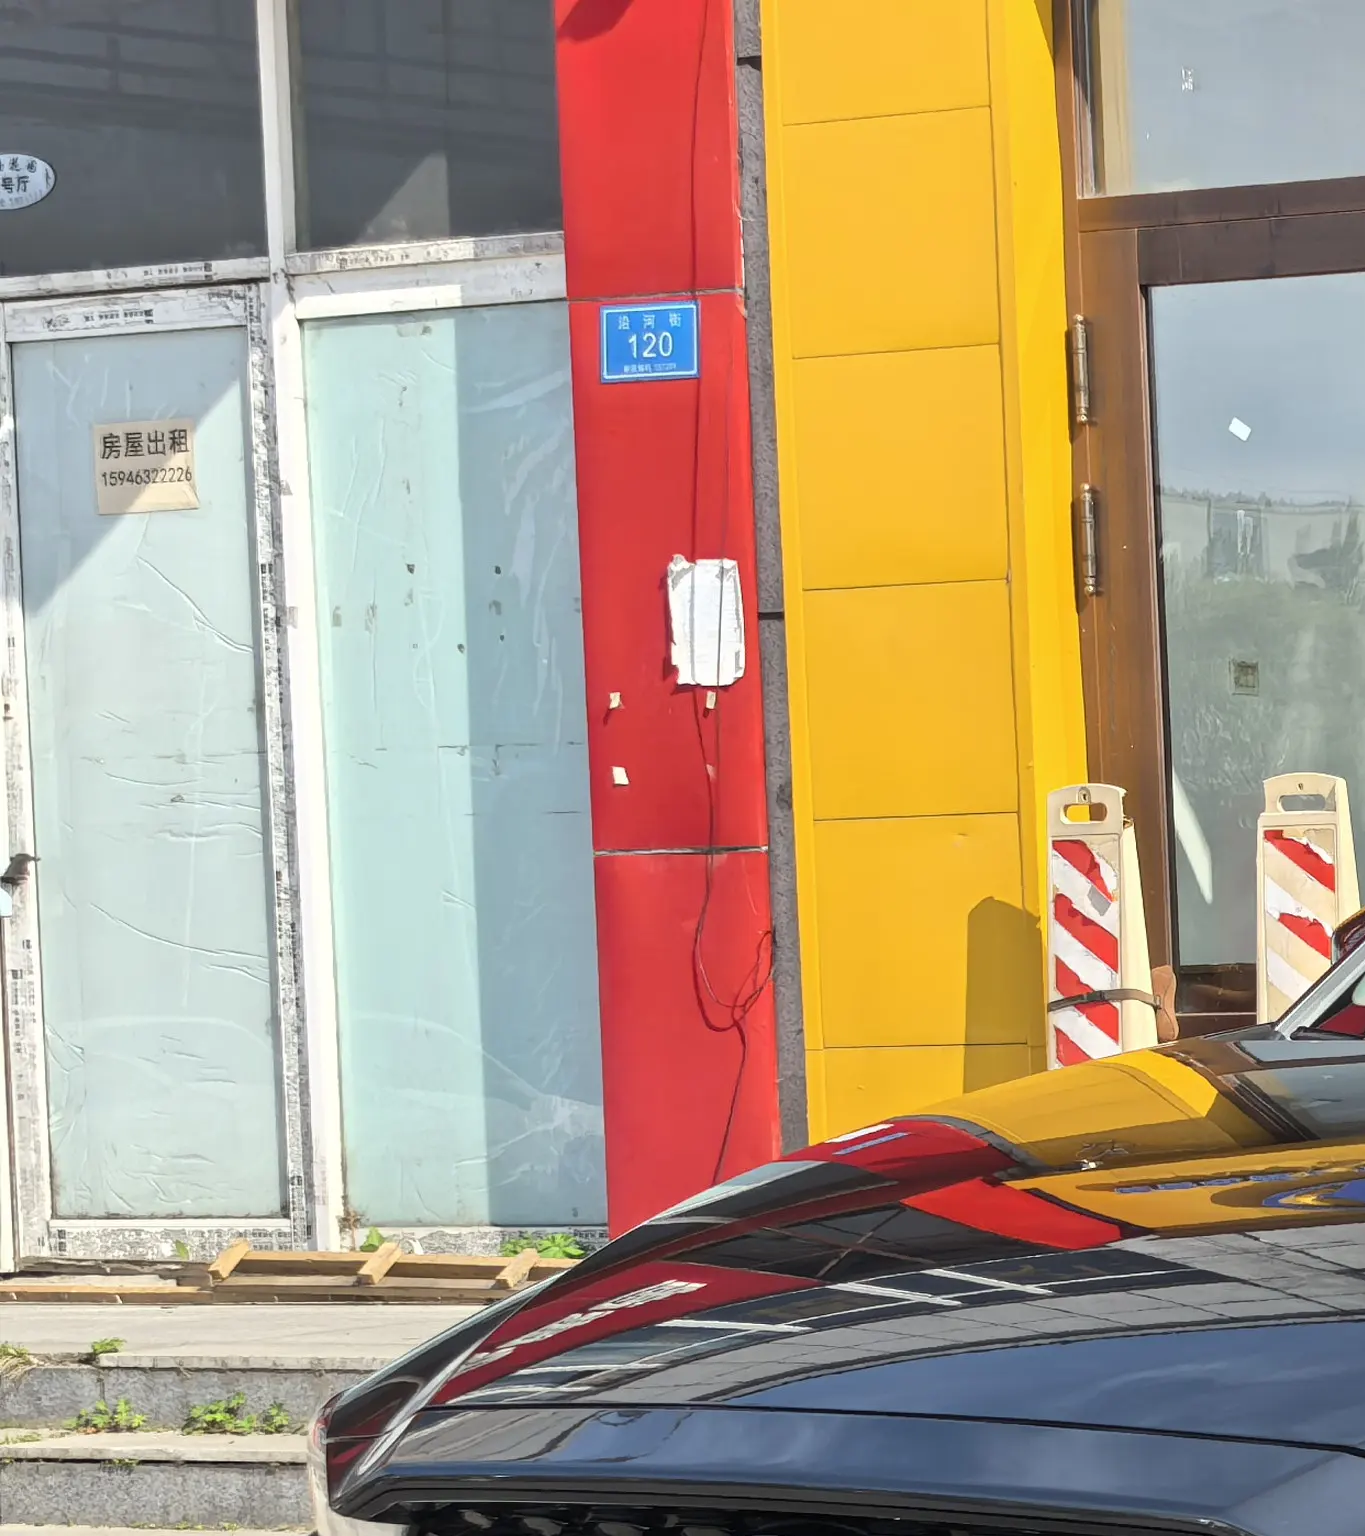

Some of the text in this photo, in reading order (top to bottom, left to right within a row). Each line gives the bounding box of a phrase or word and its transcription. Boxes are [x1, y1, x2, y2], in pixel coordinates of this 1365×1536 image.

[617, 312, 682, 331] 沿河街
[628, 331, 674, 359] 120
[100, 428, 190, 460] 房屋出租
[101, 466, 193, 487] 15946322226
